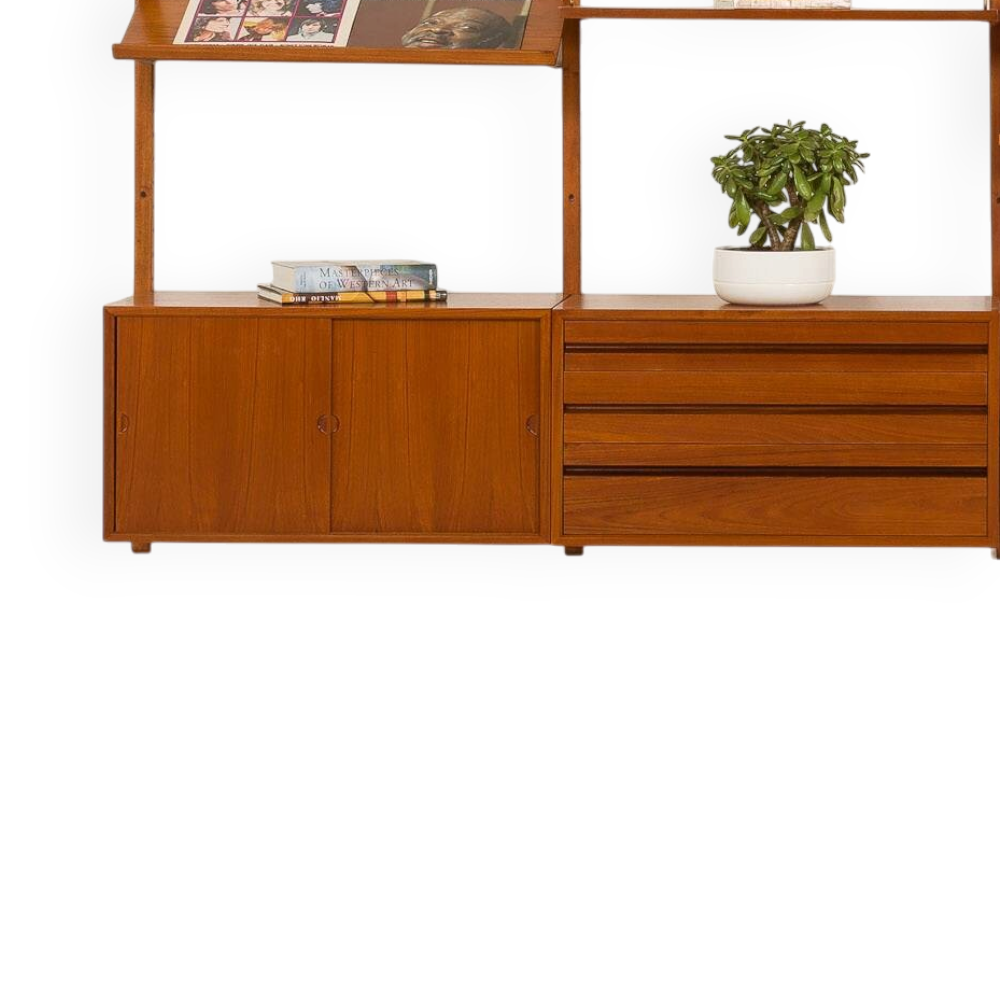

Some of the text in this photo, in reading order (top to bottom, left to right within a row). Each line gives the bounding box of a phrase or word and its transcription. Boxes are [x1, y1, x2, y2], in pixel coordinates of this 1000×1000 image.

[319, 267, 399, 278] MASTERPIECES
[319, 280, 332, 290] OF
[333, 278, 392, 289] WESTERN
[393, 278, 415, 288] ART
